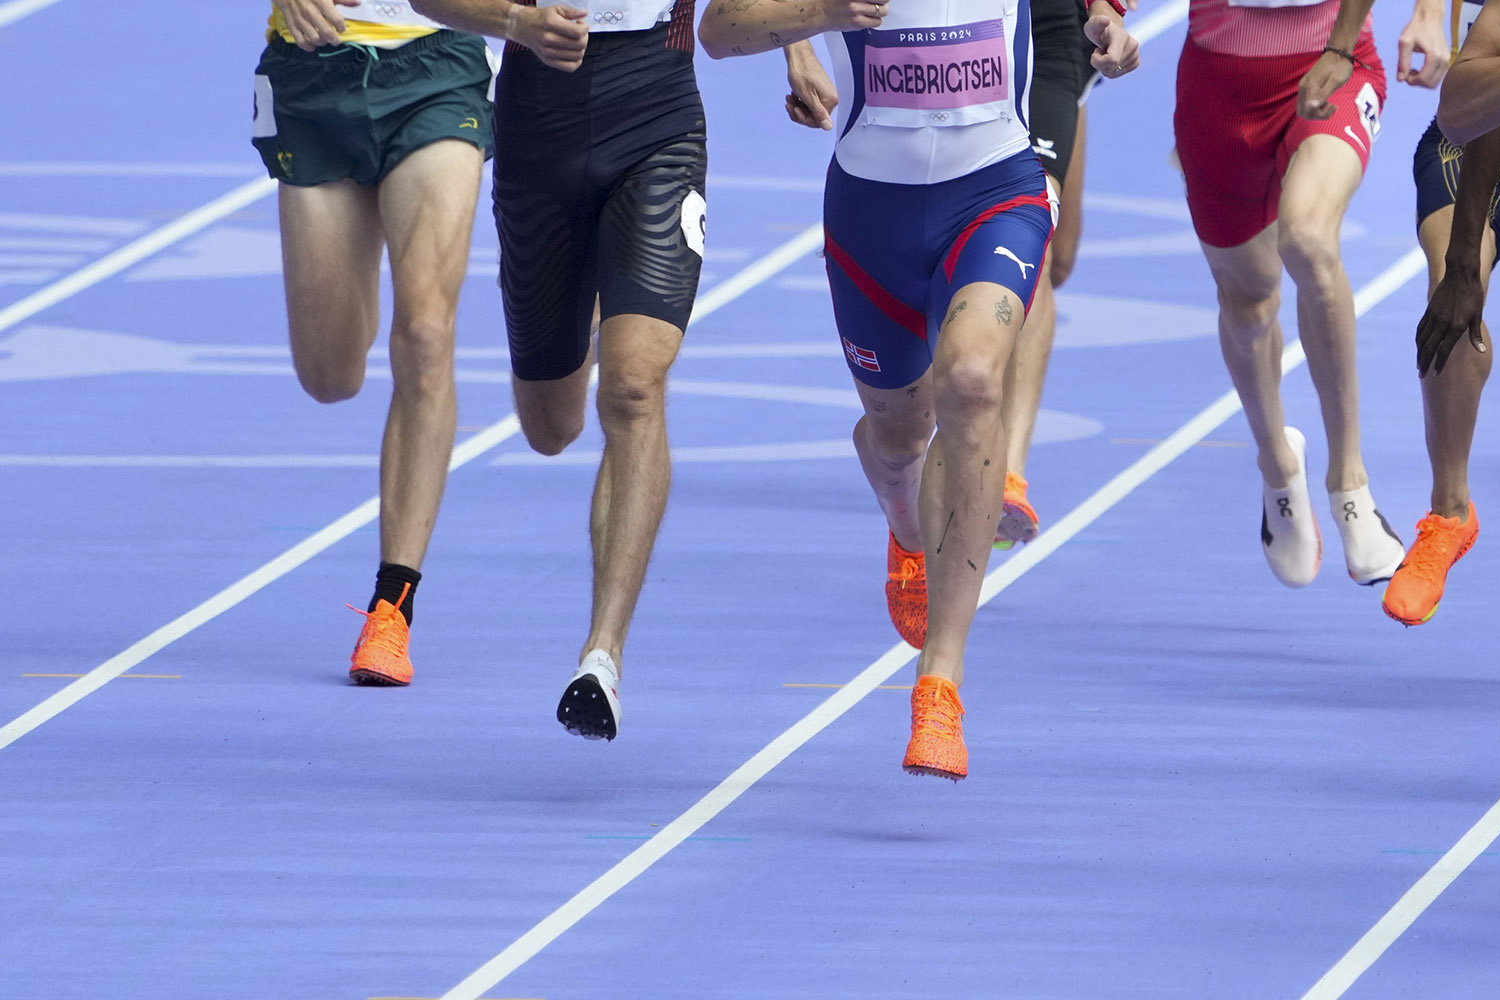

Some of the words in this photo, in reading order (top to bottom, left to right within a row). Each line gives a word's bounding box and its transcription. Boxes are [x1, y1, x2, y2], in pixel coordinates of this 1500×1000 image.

[900, 32, 936, 42] PARIS
[941, 28, 971, 41] 2024
[868, 55, 1002, 95] INGEBRIGTSEN
